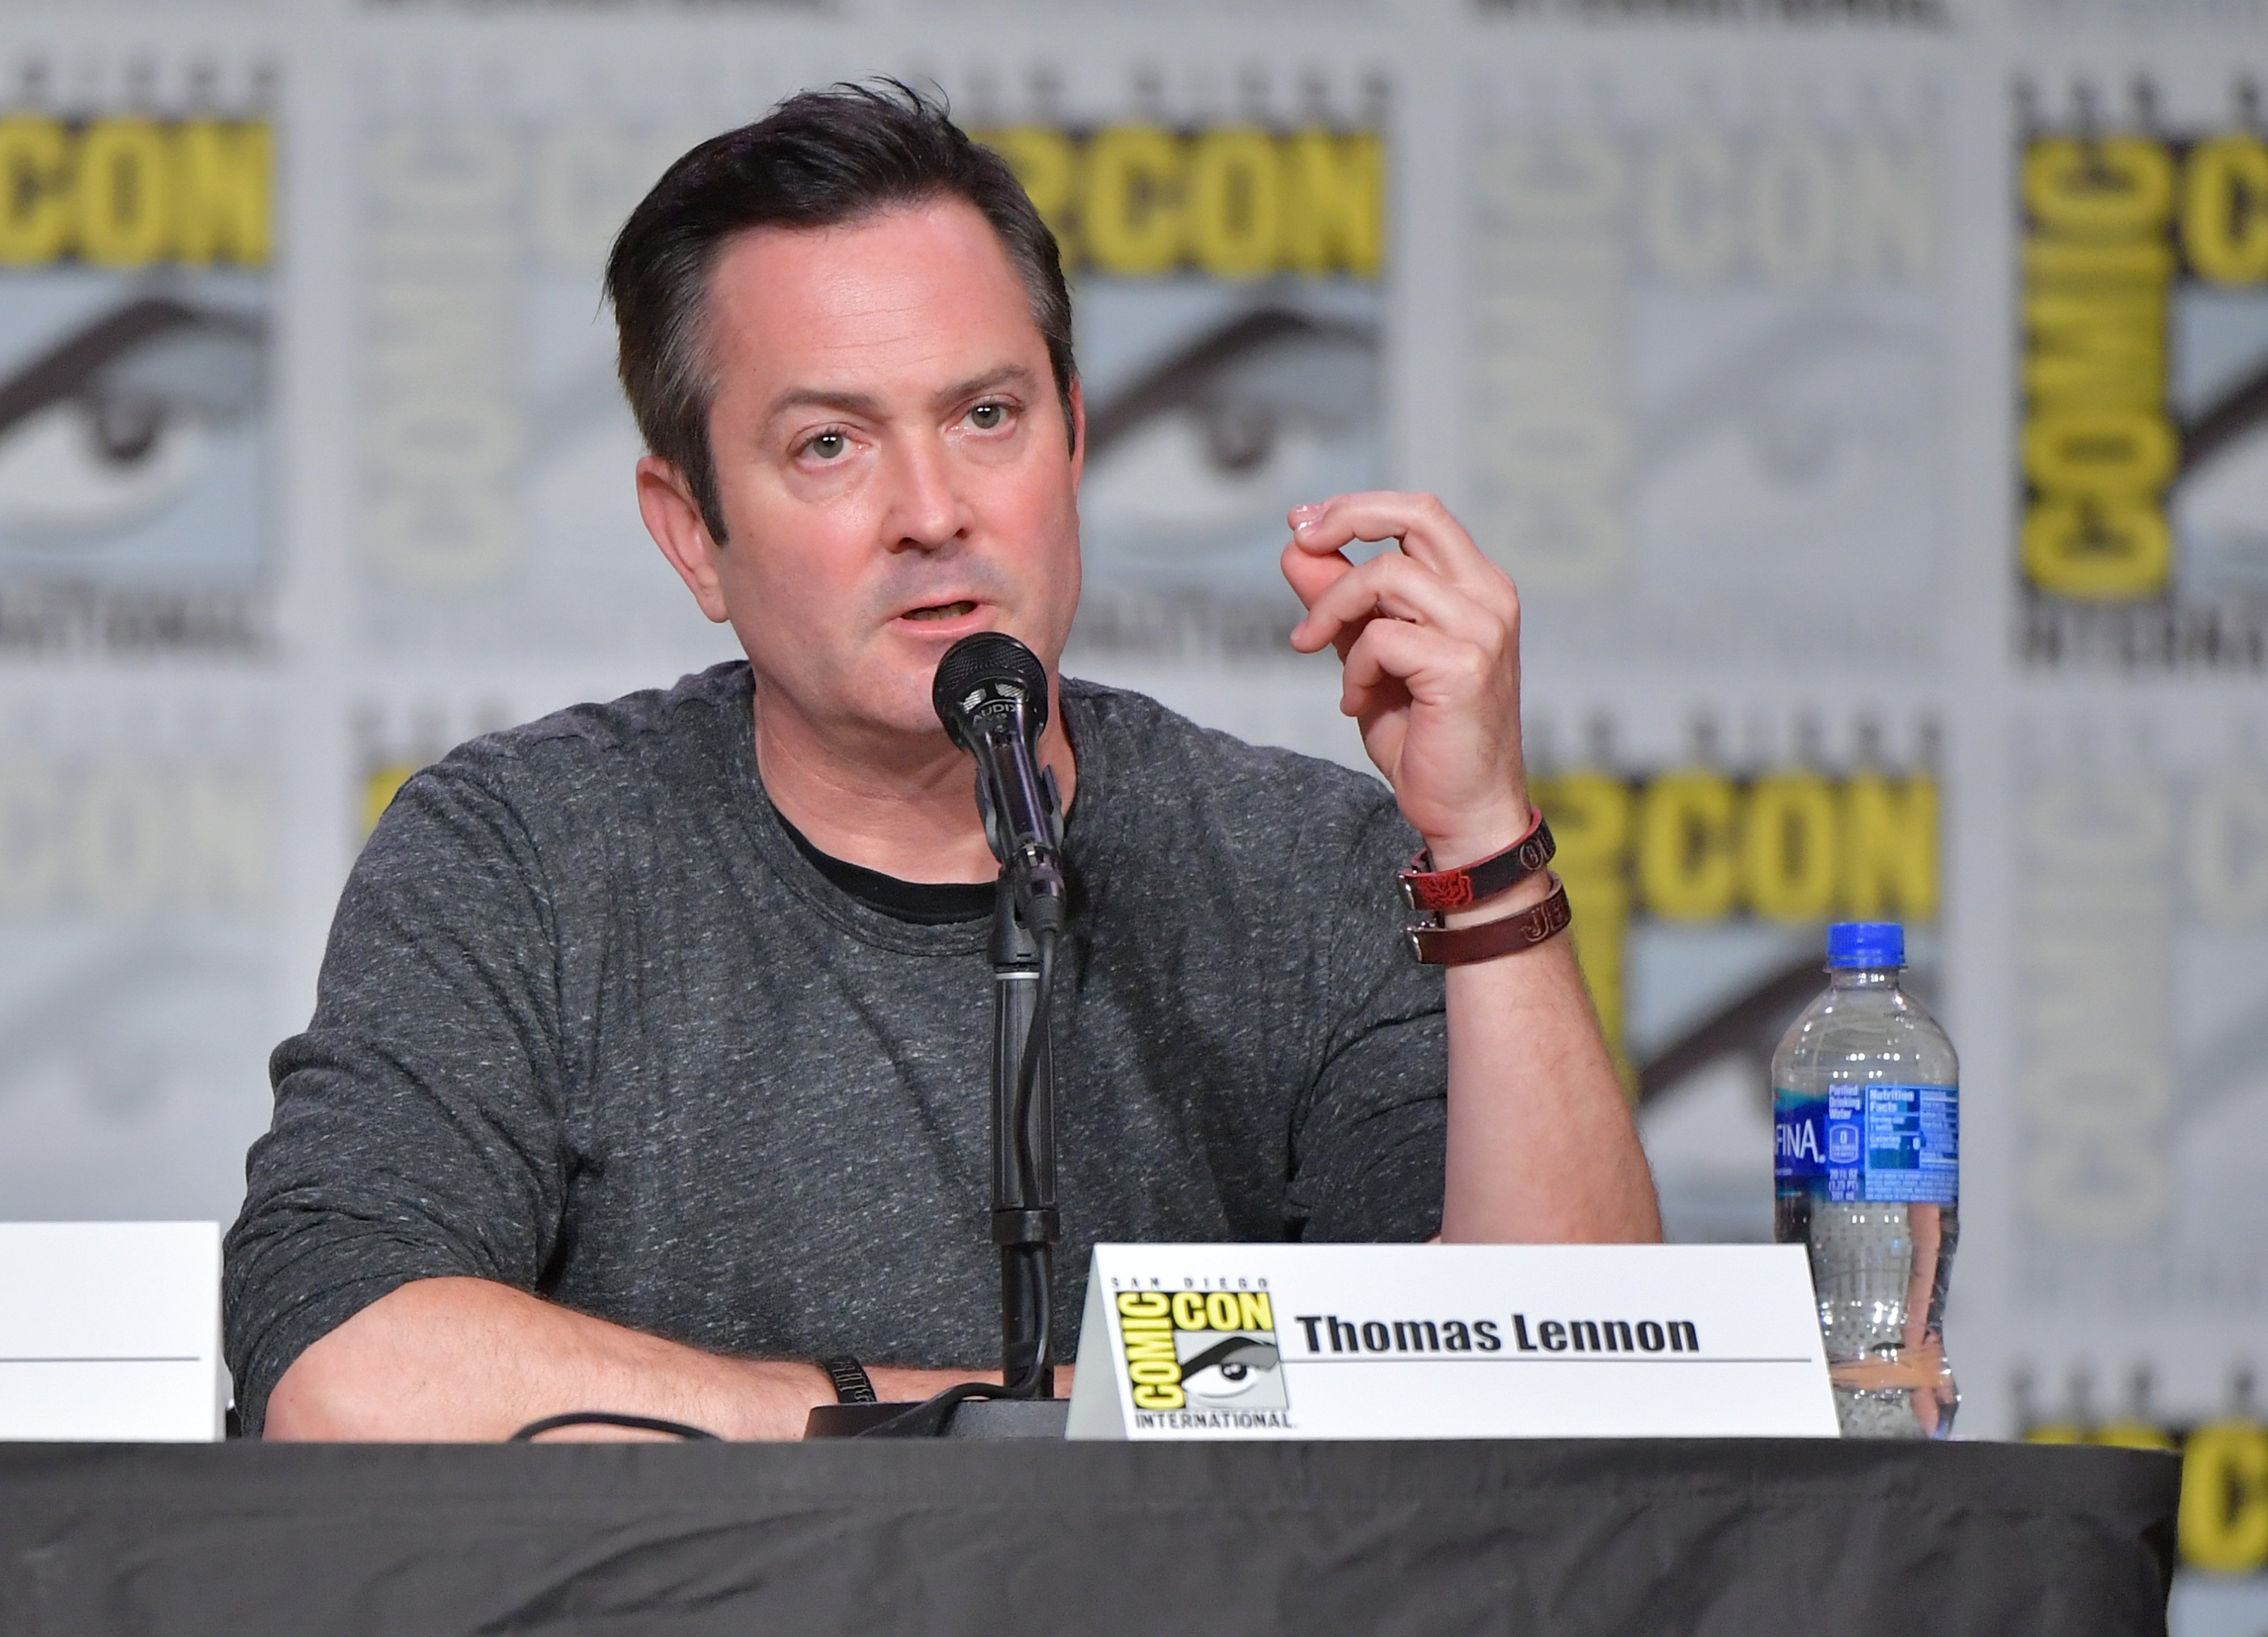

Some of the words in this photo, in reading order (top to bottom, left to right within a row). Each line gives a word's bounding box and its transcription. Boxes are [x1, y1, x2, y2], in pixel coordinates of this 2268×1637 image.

[1081, 126, 1385, 280] CON
[2019, 134, 2177, 602] COMIC
[1644, 771, 1940, 922] CON
[1869, 1089, 1915, 1102] Nutrition
[1869, 1101, 1898, 1113] Facts
[1110, 1277, 1160, 1289] SAN
[1183, 1277, 1269, 1290] DIEGO
[1171, 1291, 1274, 1331] CON
[1116, 1292, 1186, 1409] COMIC
[1294, 1314, 1501, 1354] Thomas
[1511, 1314, 1700, 1352] Lennon
